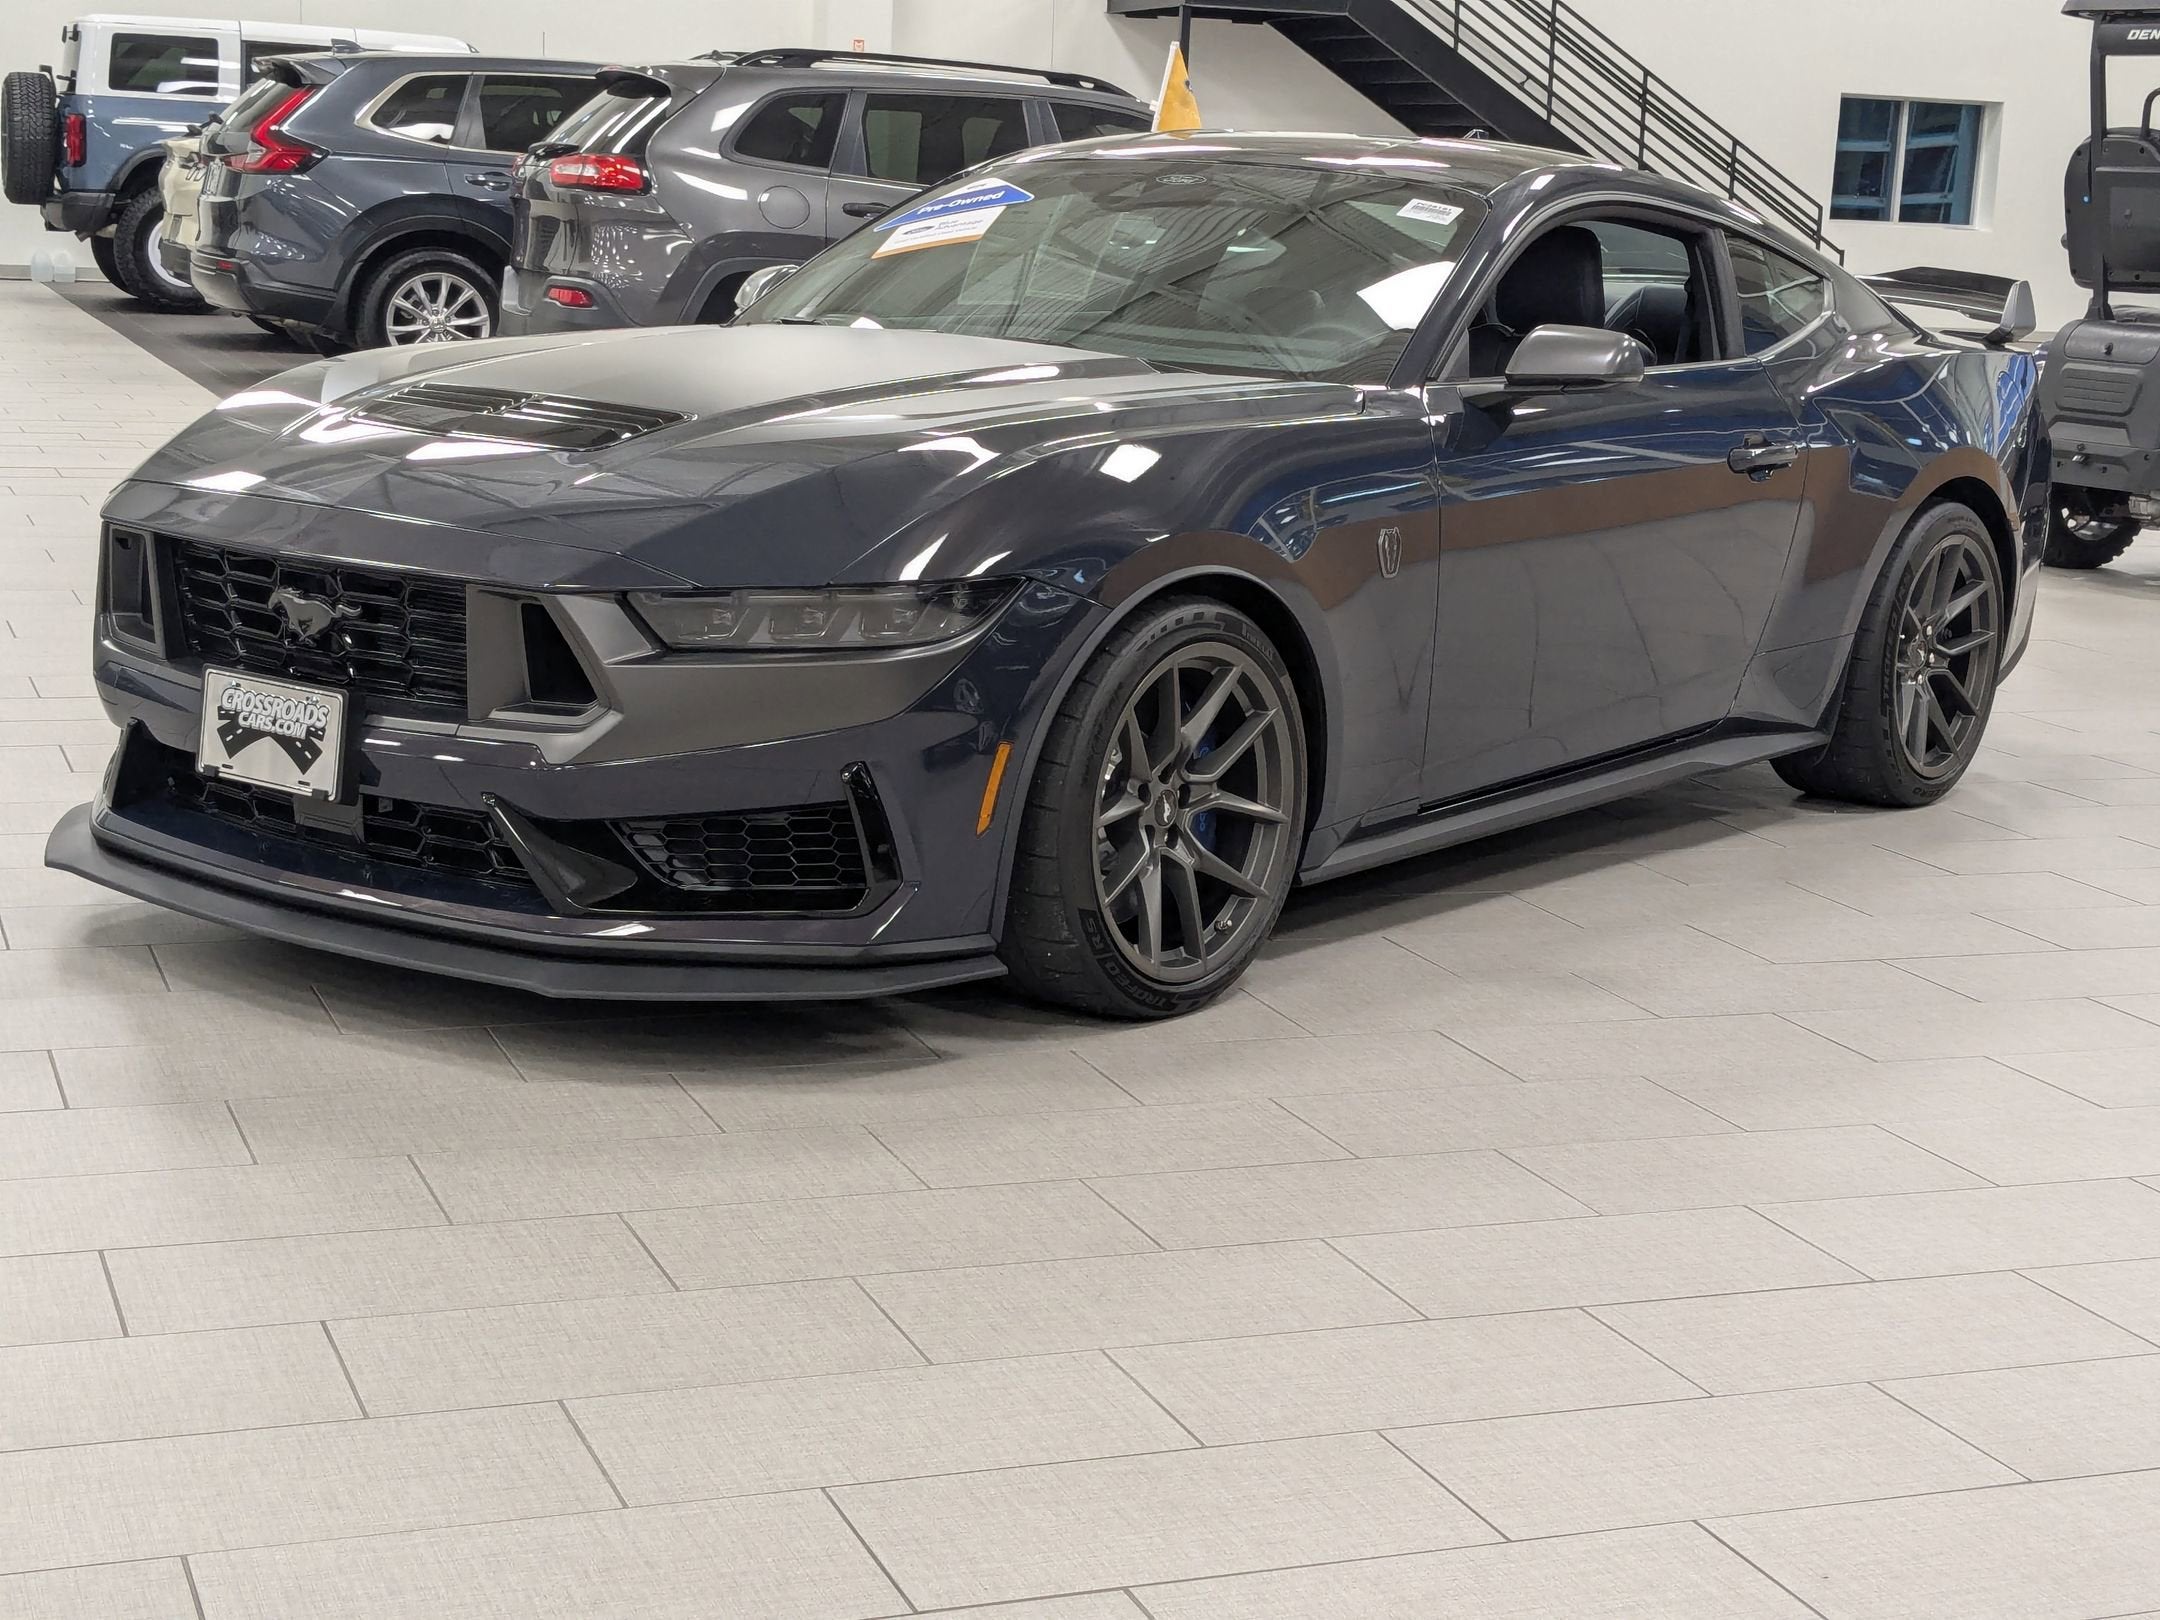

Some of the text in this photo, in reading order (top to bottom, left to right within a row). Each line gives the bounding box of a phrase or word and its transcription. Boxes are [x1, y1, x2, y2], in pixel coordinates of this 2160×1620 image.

[917, 190, 1006, 215] Pre-Owned
[221, 687, 330, 728] CROSSROADS
[238, 711, 308, 740] CARS.COM
